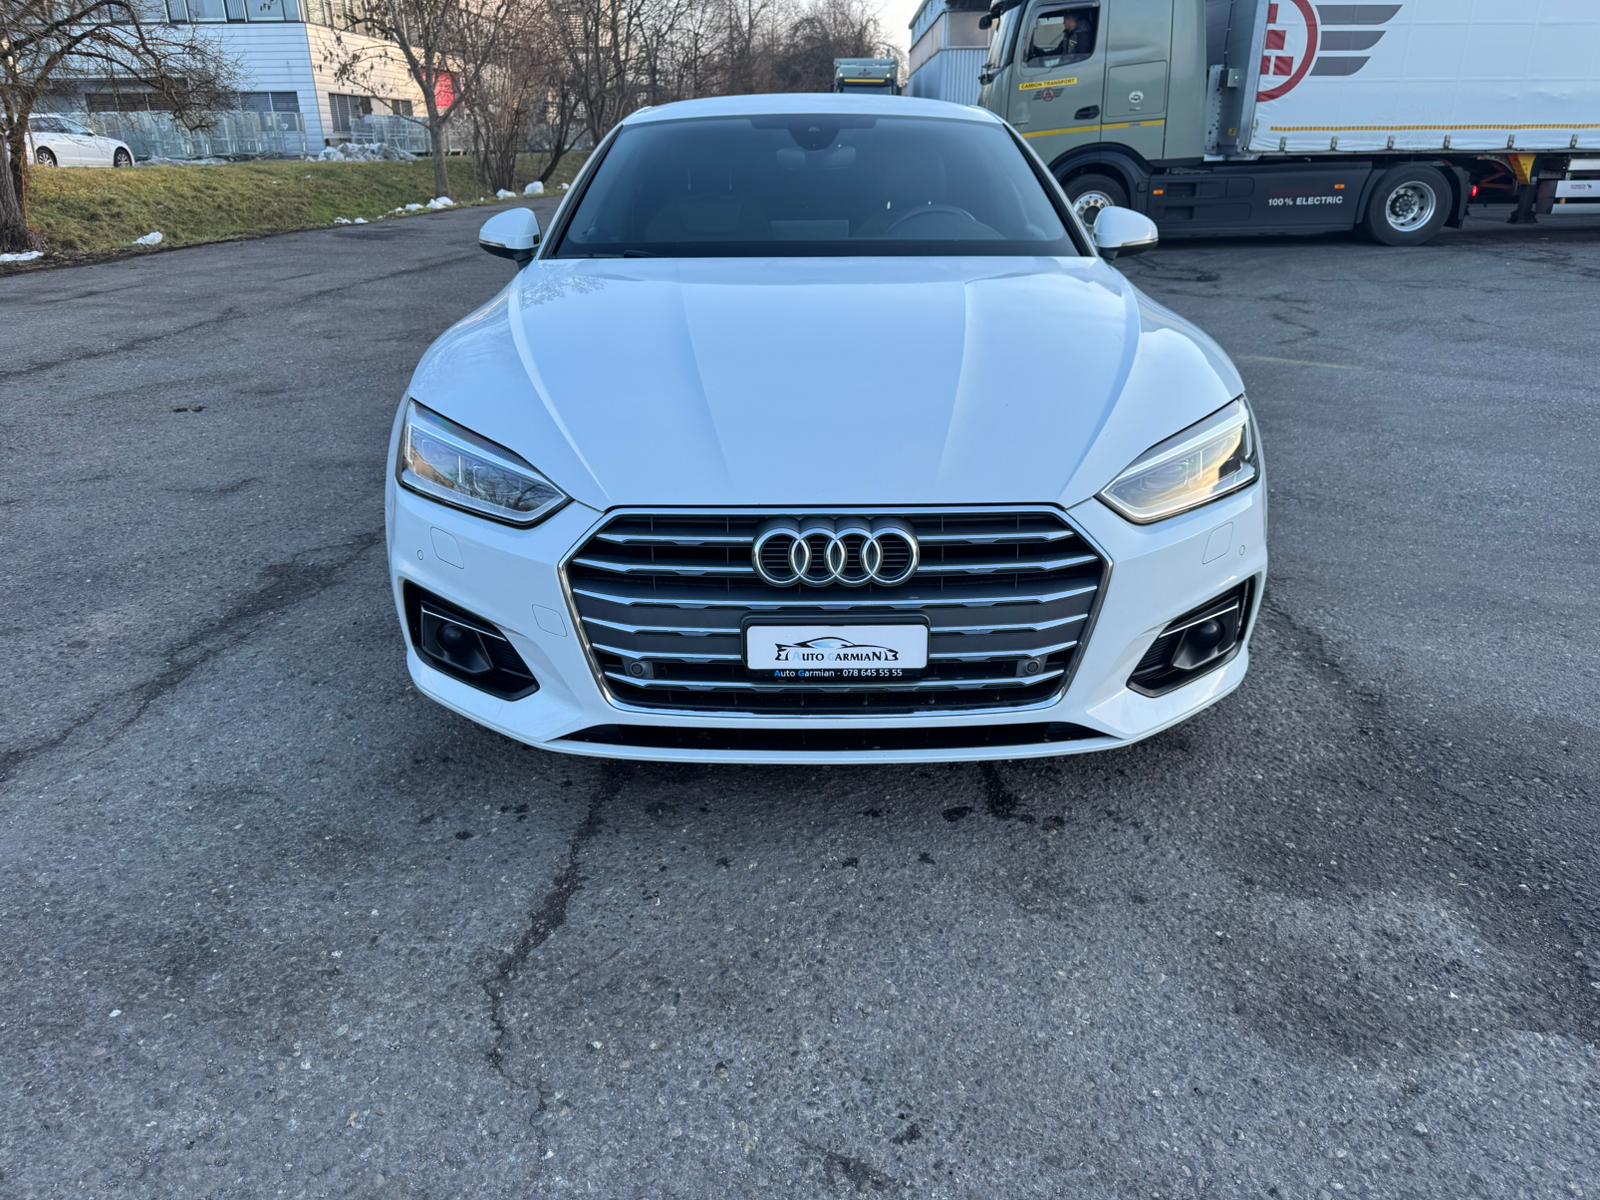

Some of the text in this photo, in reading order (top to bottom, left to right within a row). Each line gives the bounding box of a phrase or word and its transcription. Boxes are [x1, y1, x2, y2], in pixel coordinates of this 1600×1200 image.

[1043, 78, 1075, 86] TRANSPORT
[1296, 195, 1343, 205] ELECTRIC
[798, 669, 834, 677] Garmian
[843, 669, 858, 677] 078
[861, 669, 877, 677] 645
[879, 669, 889, 677] 55
[892, 669, 902, 677] 55
